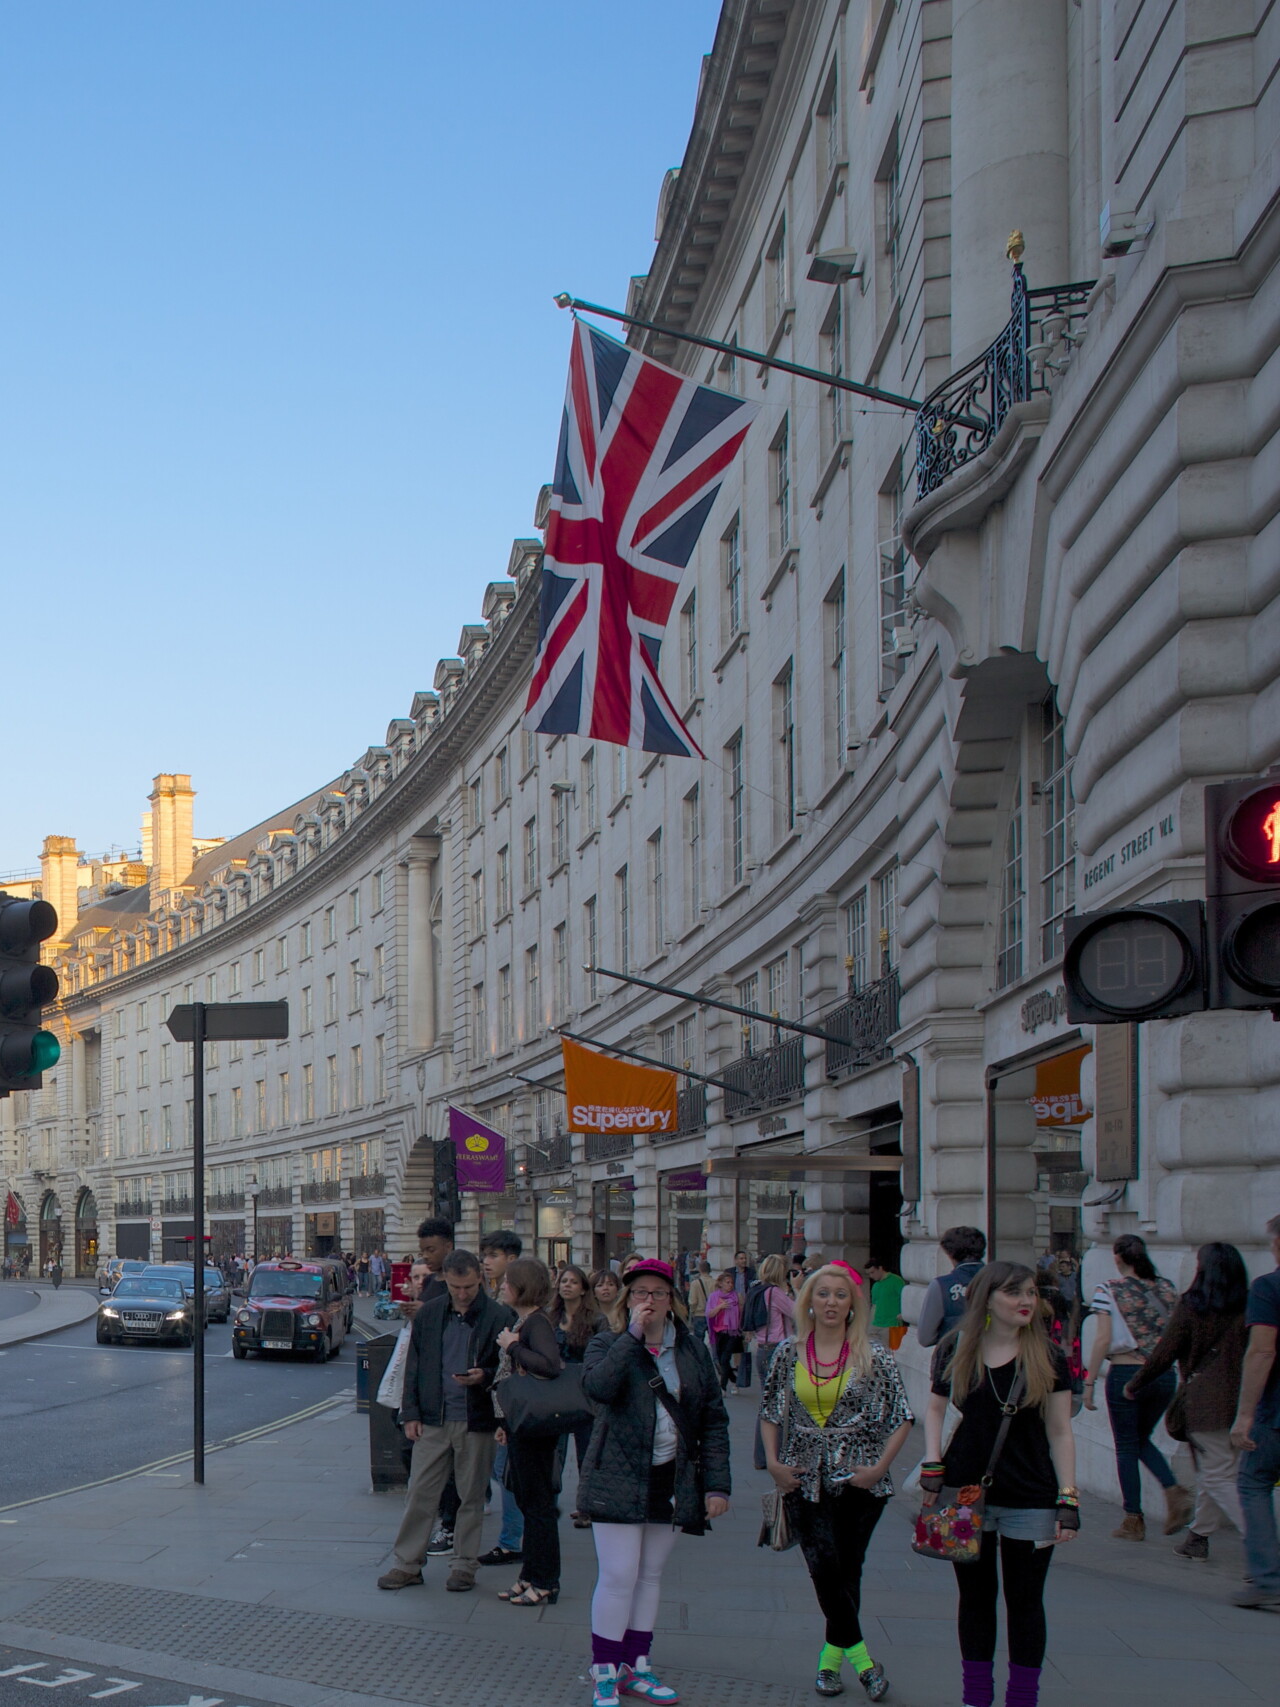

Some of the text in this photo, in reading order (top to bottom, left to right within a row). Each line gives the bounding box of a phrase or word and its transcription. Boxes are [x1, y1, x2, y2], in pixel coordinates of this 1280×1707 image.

[1083, 853, 1115, 891] REGENT
[1120, 826, 1155, 865] STREET
[572, 1105, 671, 1132] Superdry
[546, 1195, 573, 1204] Clarks
